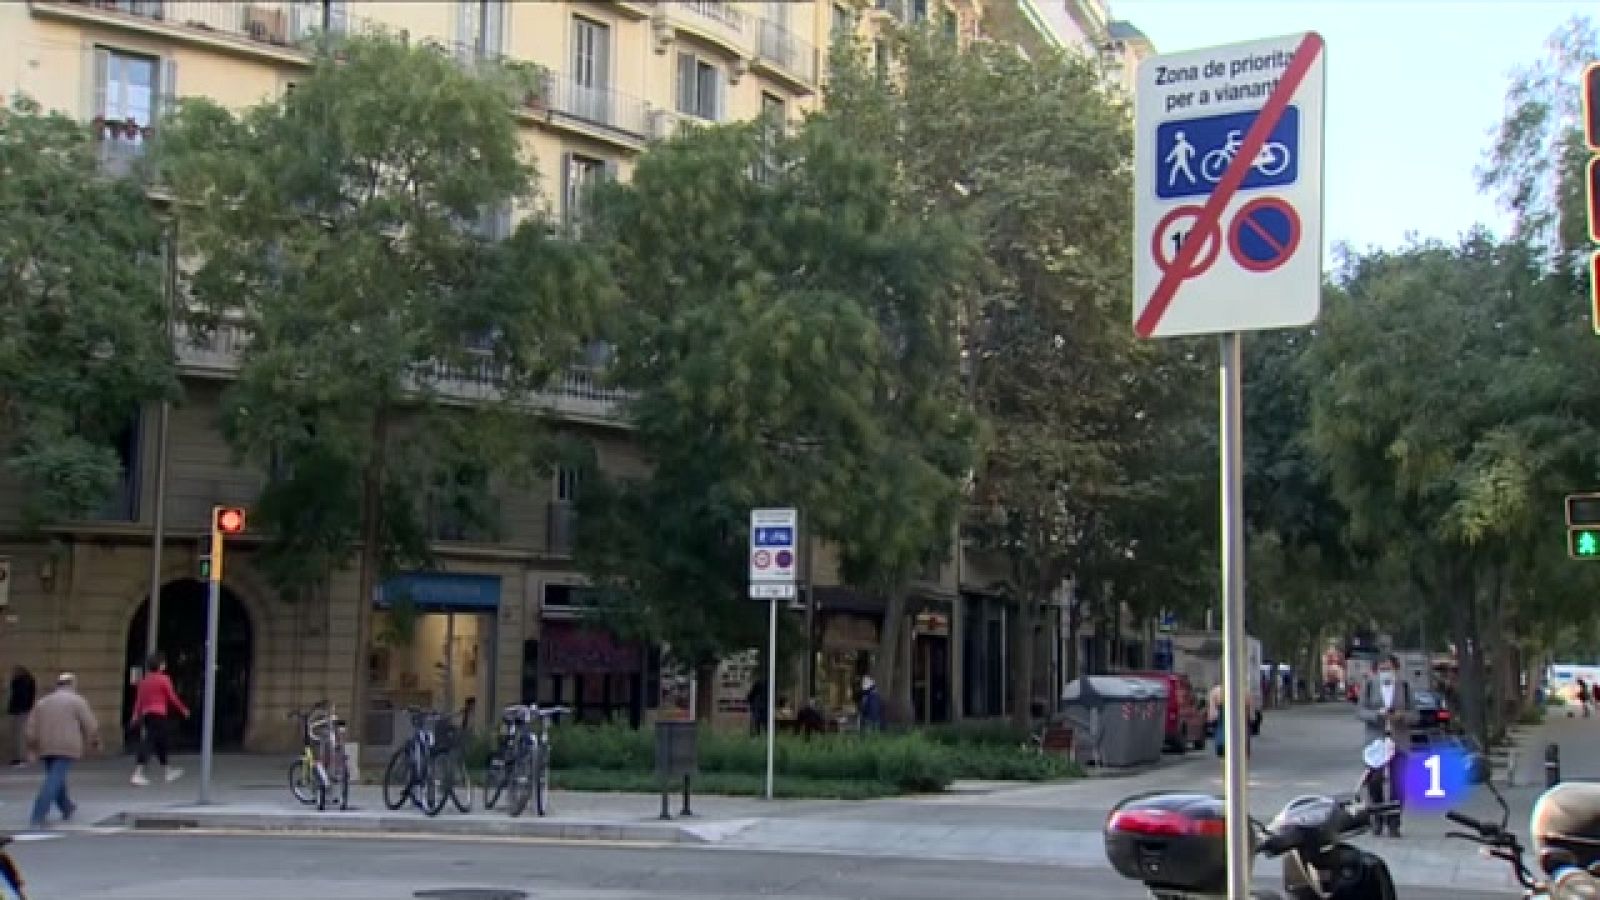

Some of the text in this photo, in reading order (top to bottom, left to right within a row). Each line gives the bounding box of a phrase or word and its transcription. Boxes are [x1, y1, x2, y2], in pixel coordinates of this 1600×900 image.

[1154, 50, 1297, 85] Zona de priorita
[1165, 77, 1280, 113] per a vianant
